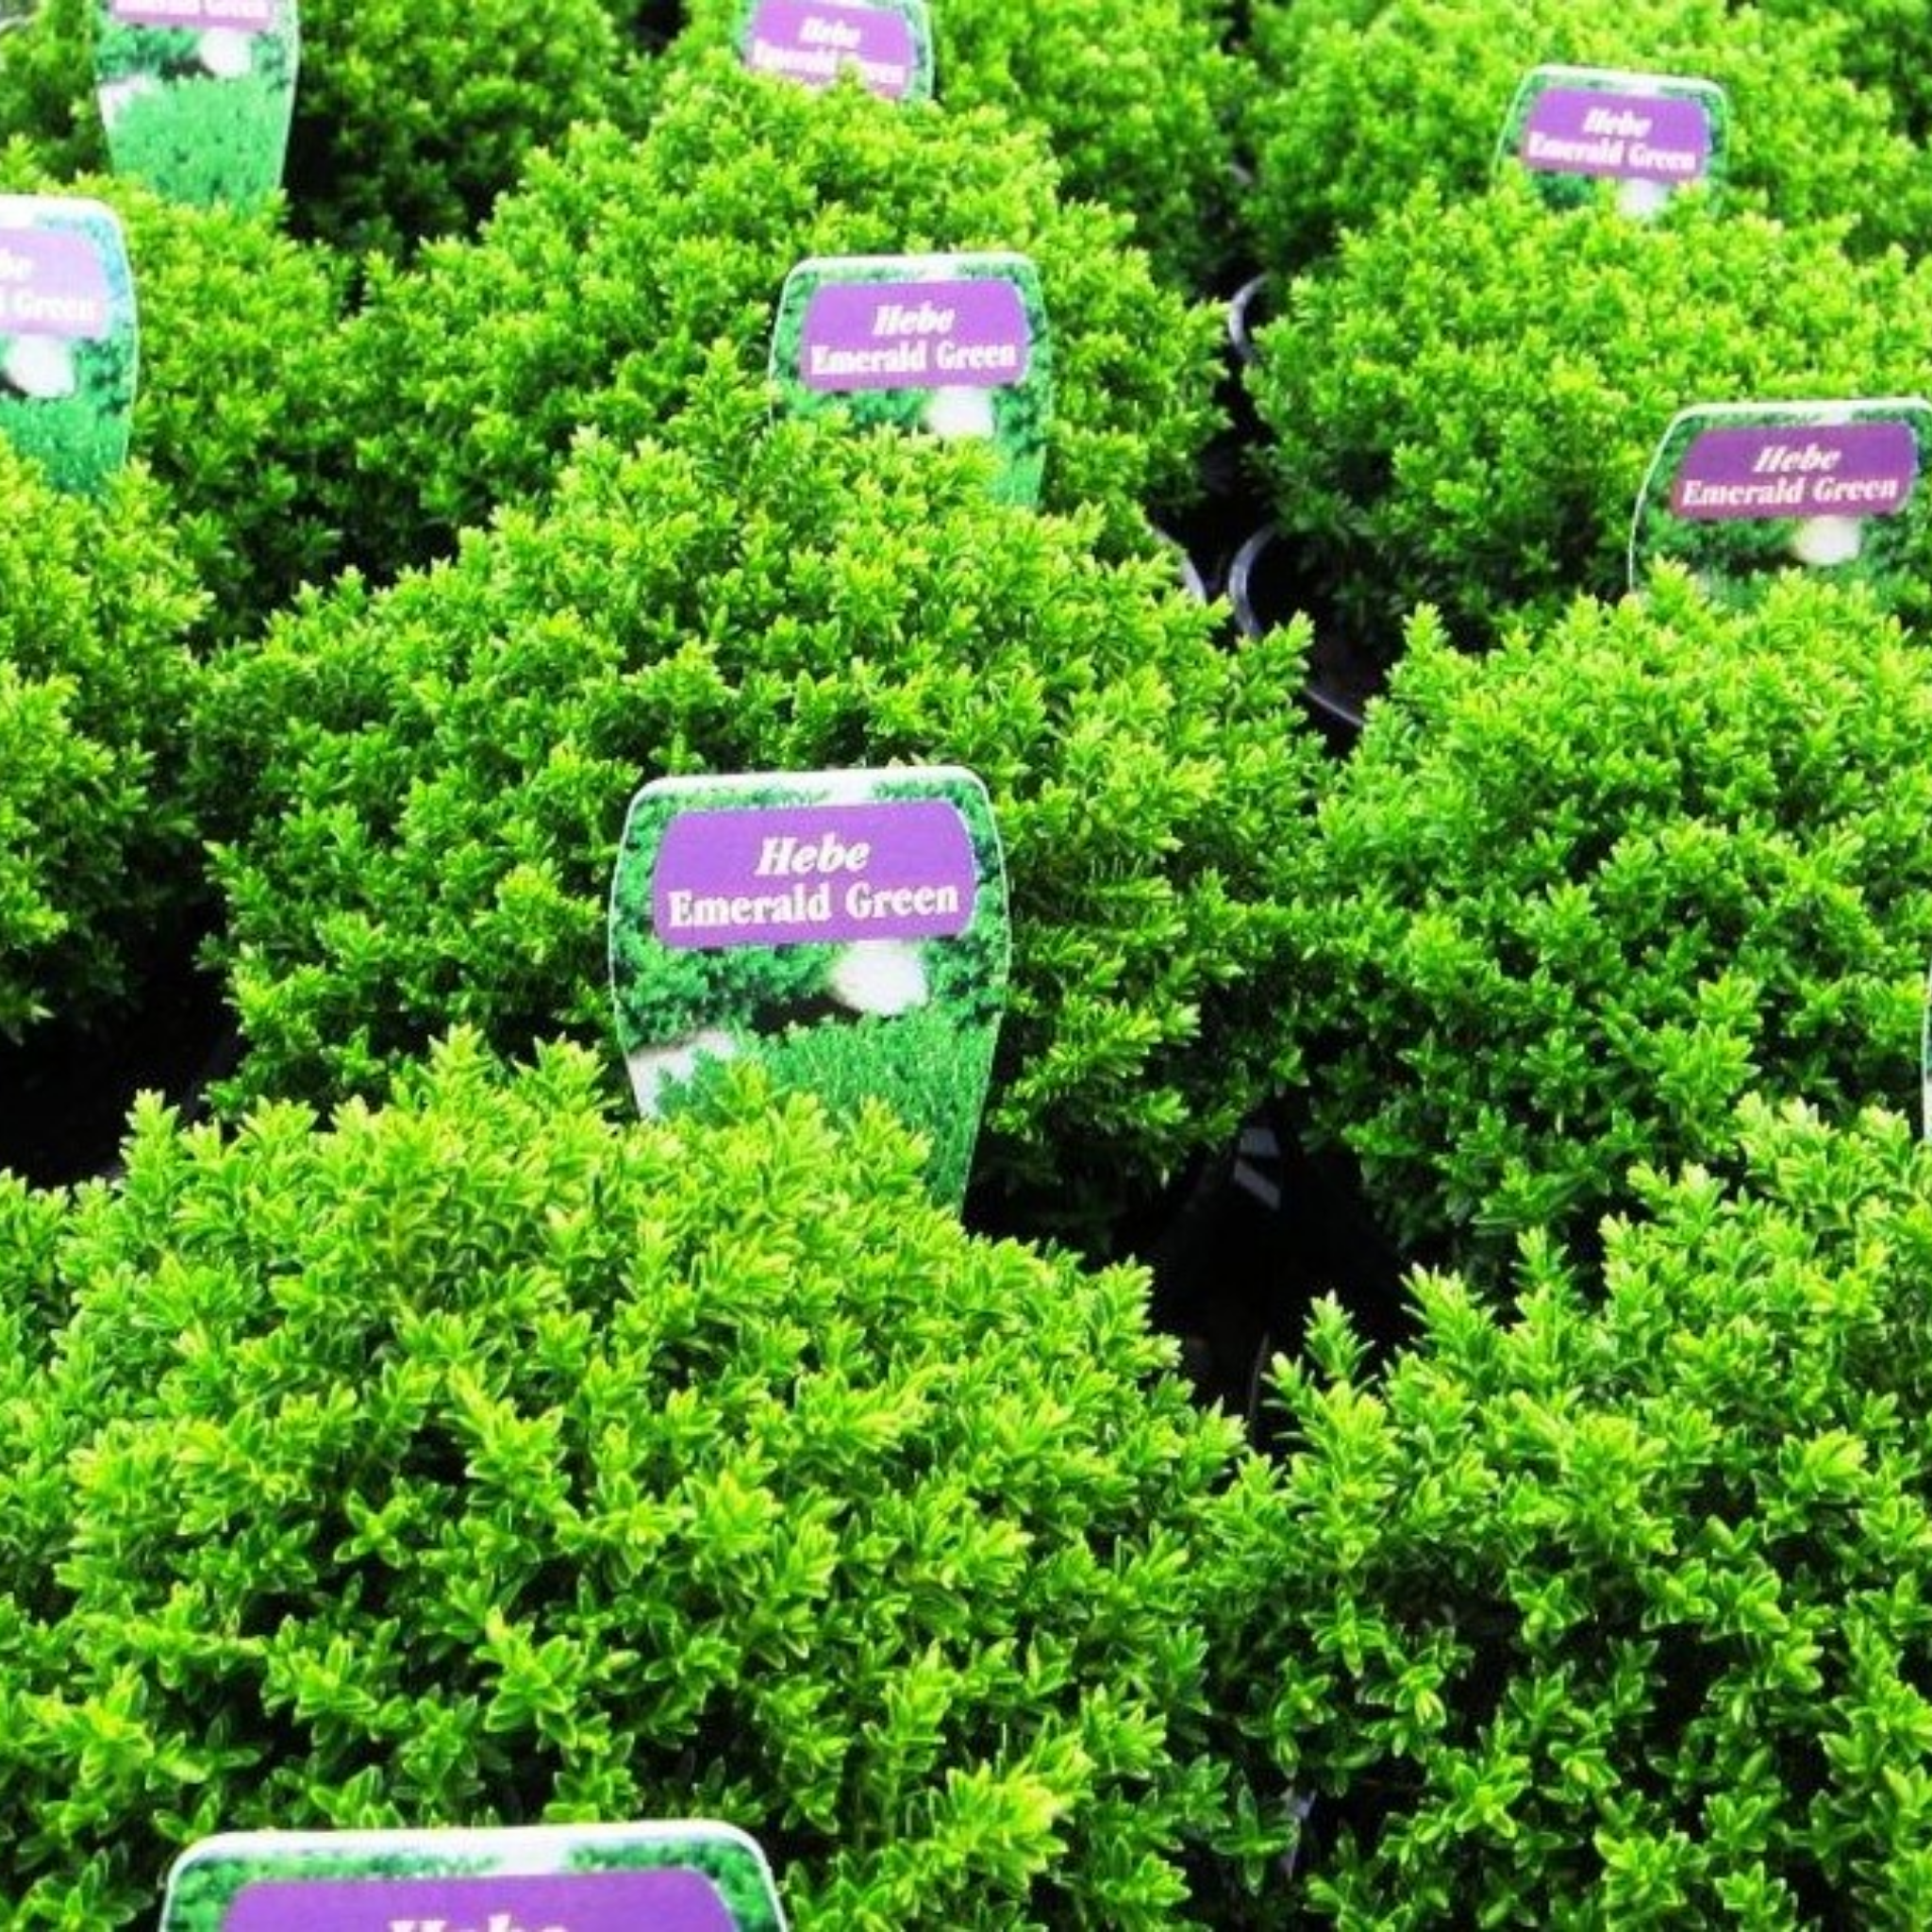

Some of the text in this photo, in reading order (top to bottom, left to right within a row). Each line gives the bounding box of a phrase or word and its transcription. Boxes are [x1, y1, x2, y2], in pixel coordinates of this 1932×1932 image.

[1582, 107, 1653, 138] Hebe
[1529, 131, 1696, 171] Emerald Green
[872, 300, 956, 336] Hebe
[810, 340, 1018, 375] Emerald Green
[1753, 443, 1841, 473] Hebe
[1682, 476, 1898, 507] Emerald Green
[755, 832, 872, 876] Hebe
[668, 882, 959, 927] Emerald Green
